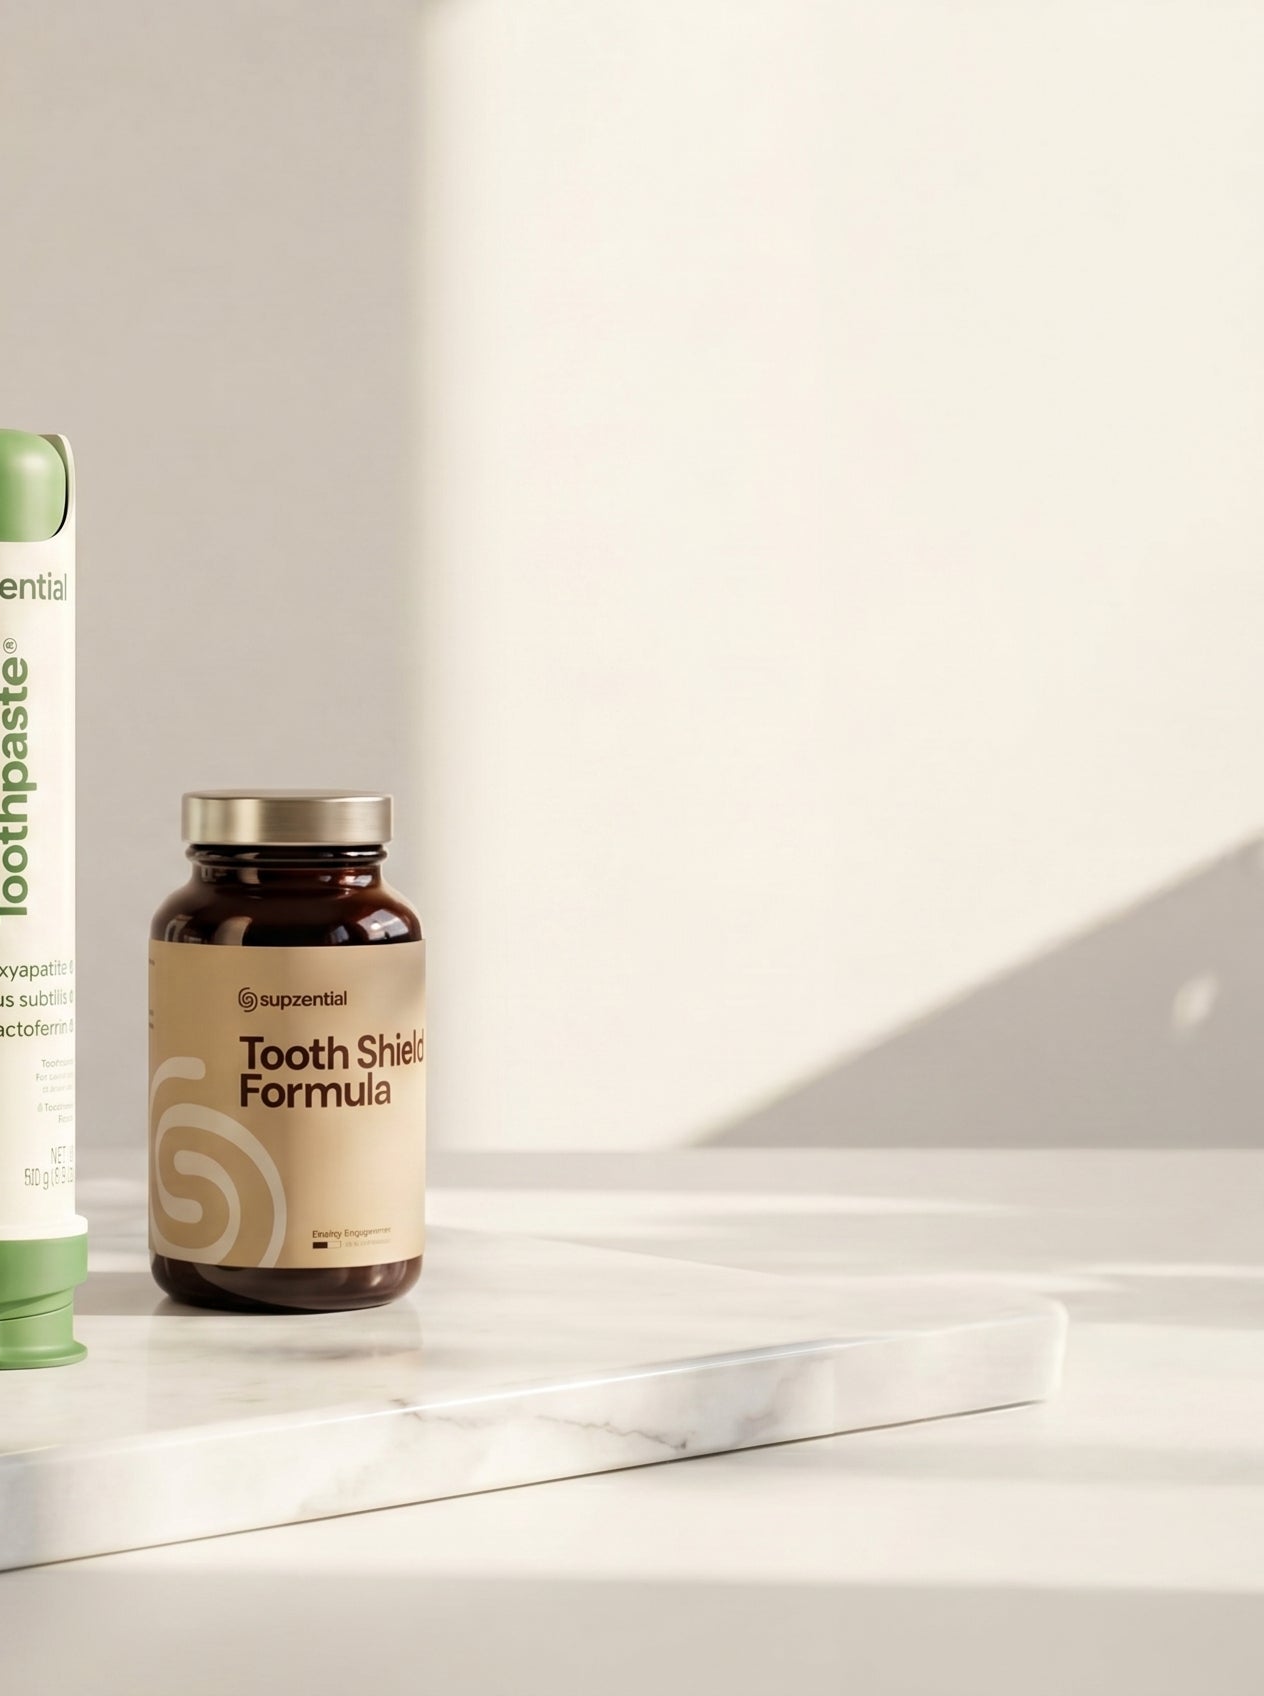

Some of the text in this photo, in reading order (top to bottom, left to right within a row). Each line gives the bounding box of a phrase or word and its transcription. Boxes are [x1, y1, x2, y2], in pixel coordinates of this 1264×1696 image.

[19, 989, 67, 1007] subtilis
[260, 991, 347, 1010] supzential
[239, 1028, 424, 1070] Tooth Shield
[240, 1072, 391, 1108] Formula
